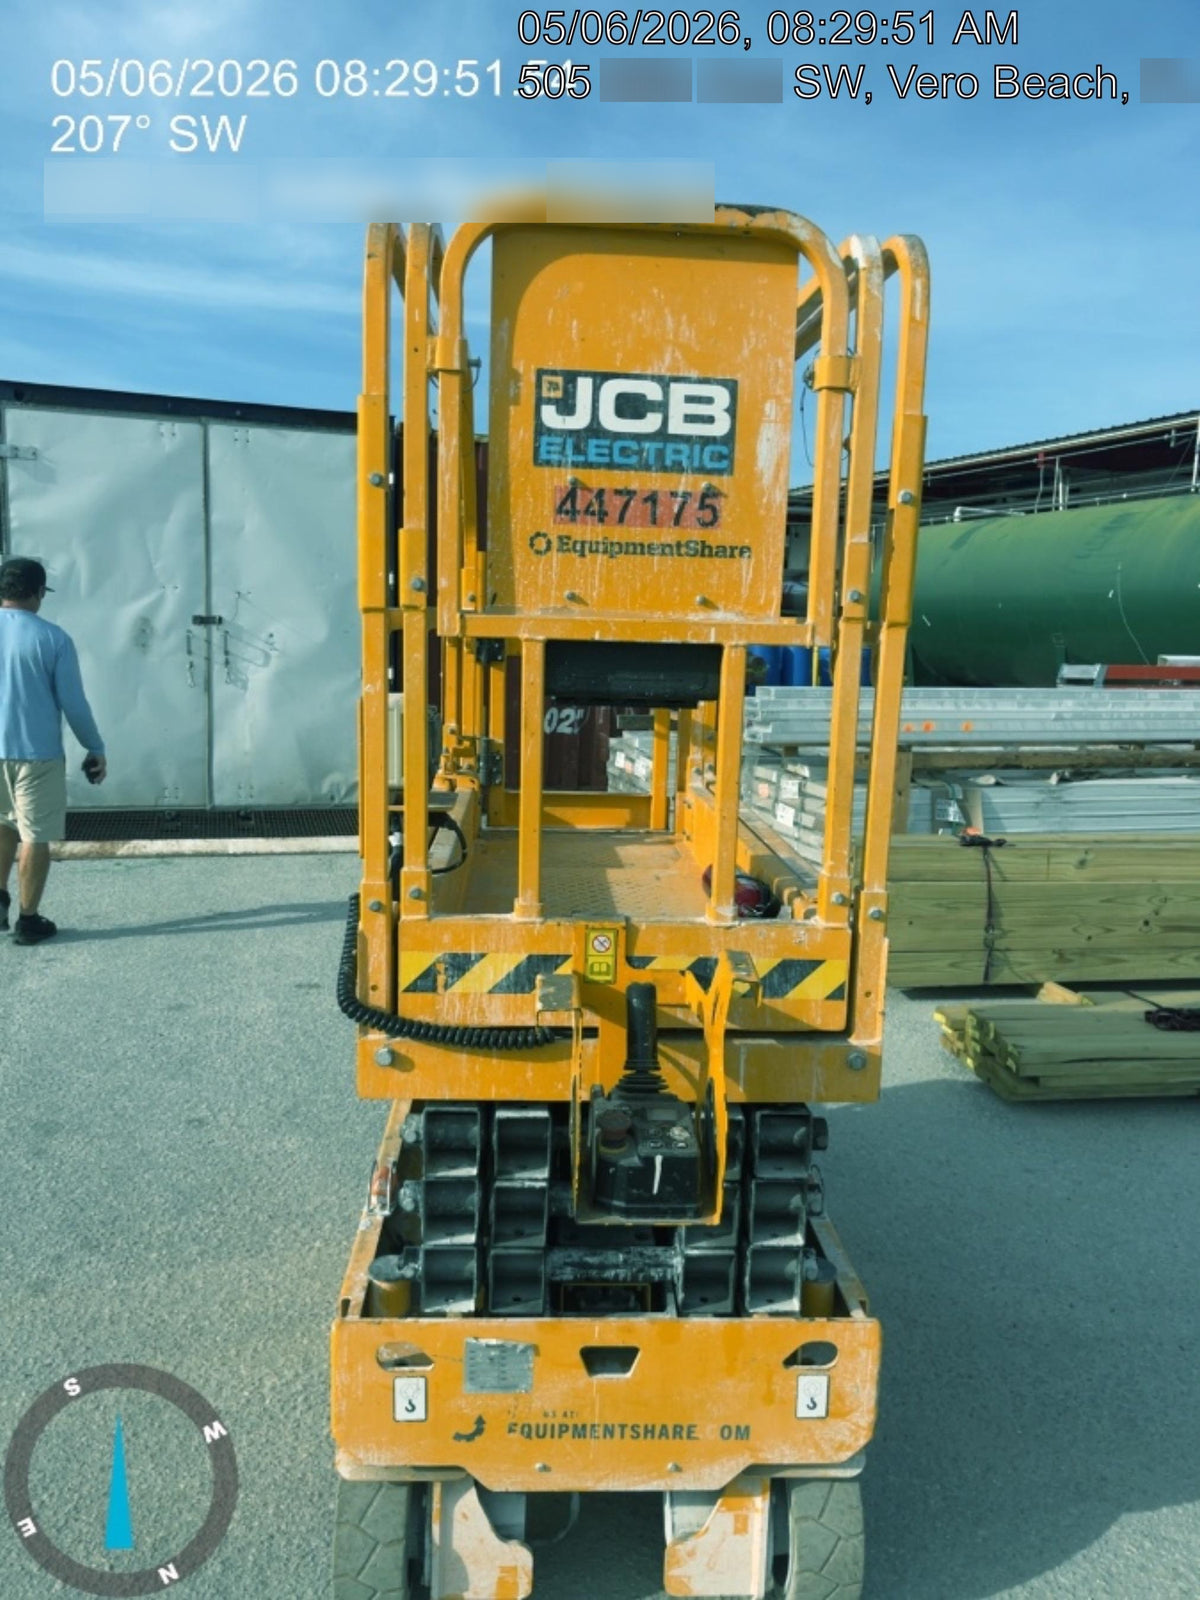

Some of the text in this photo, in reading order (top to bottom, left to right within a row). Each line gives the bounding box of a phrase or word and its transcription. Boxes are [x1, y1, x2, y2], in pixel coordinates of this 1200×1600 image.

[540, 376, 732, 437] JCB
[538, 436, 730, 470] ELECTRIC
[555, 486, 721, 528] 447175
[556, 534, 752, 559] EquipmentShare
